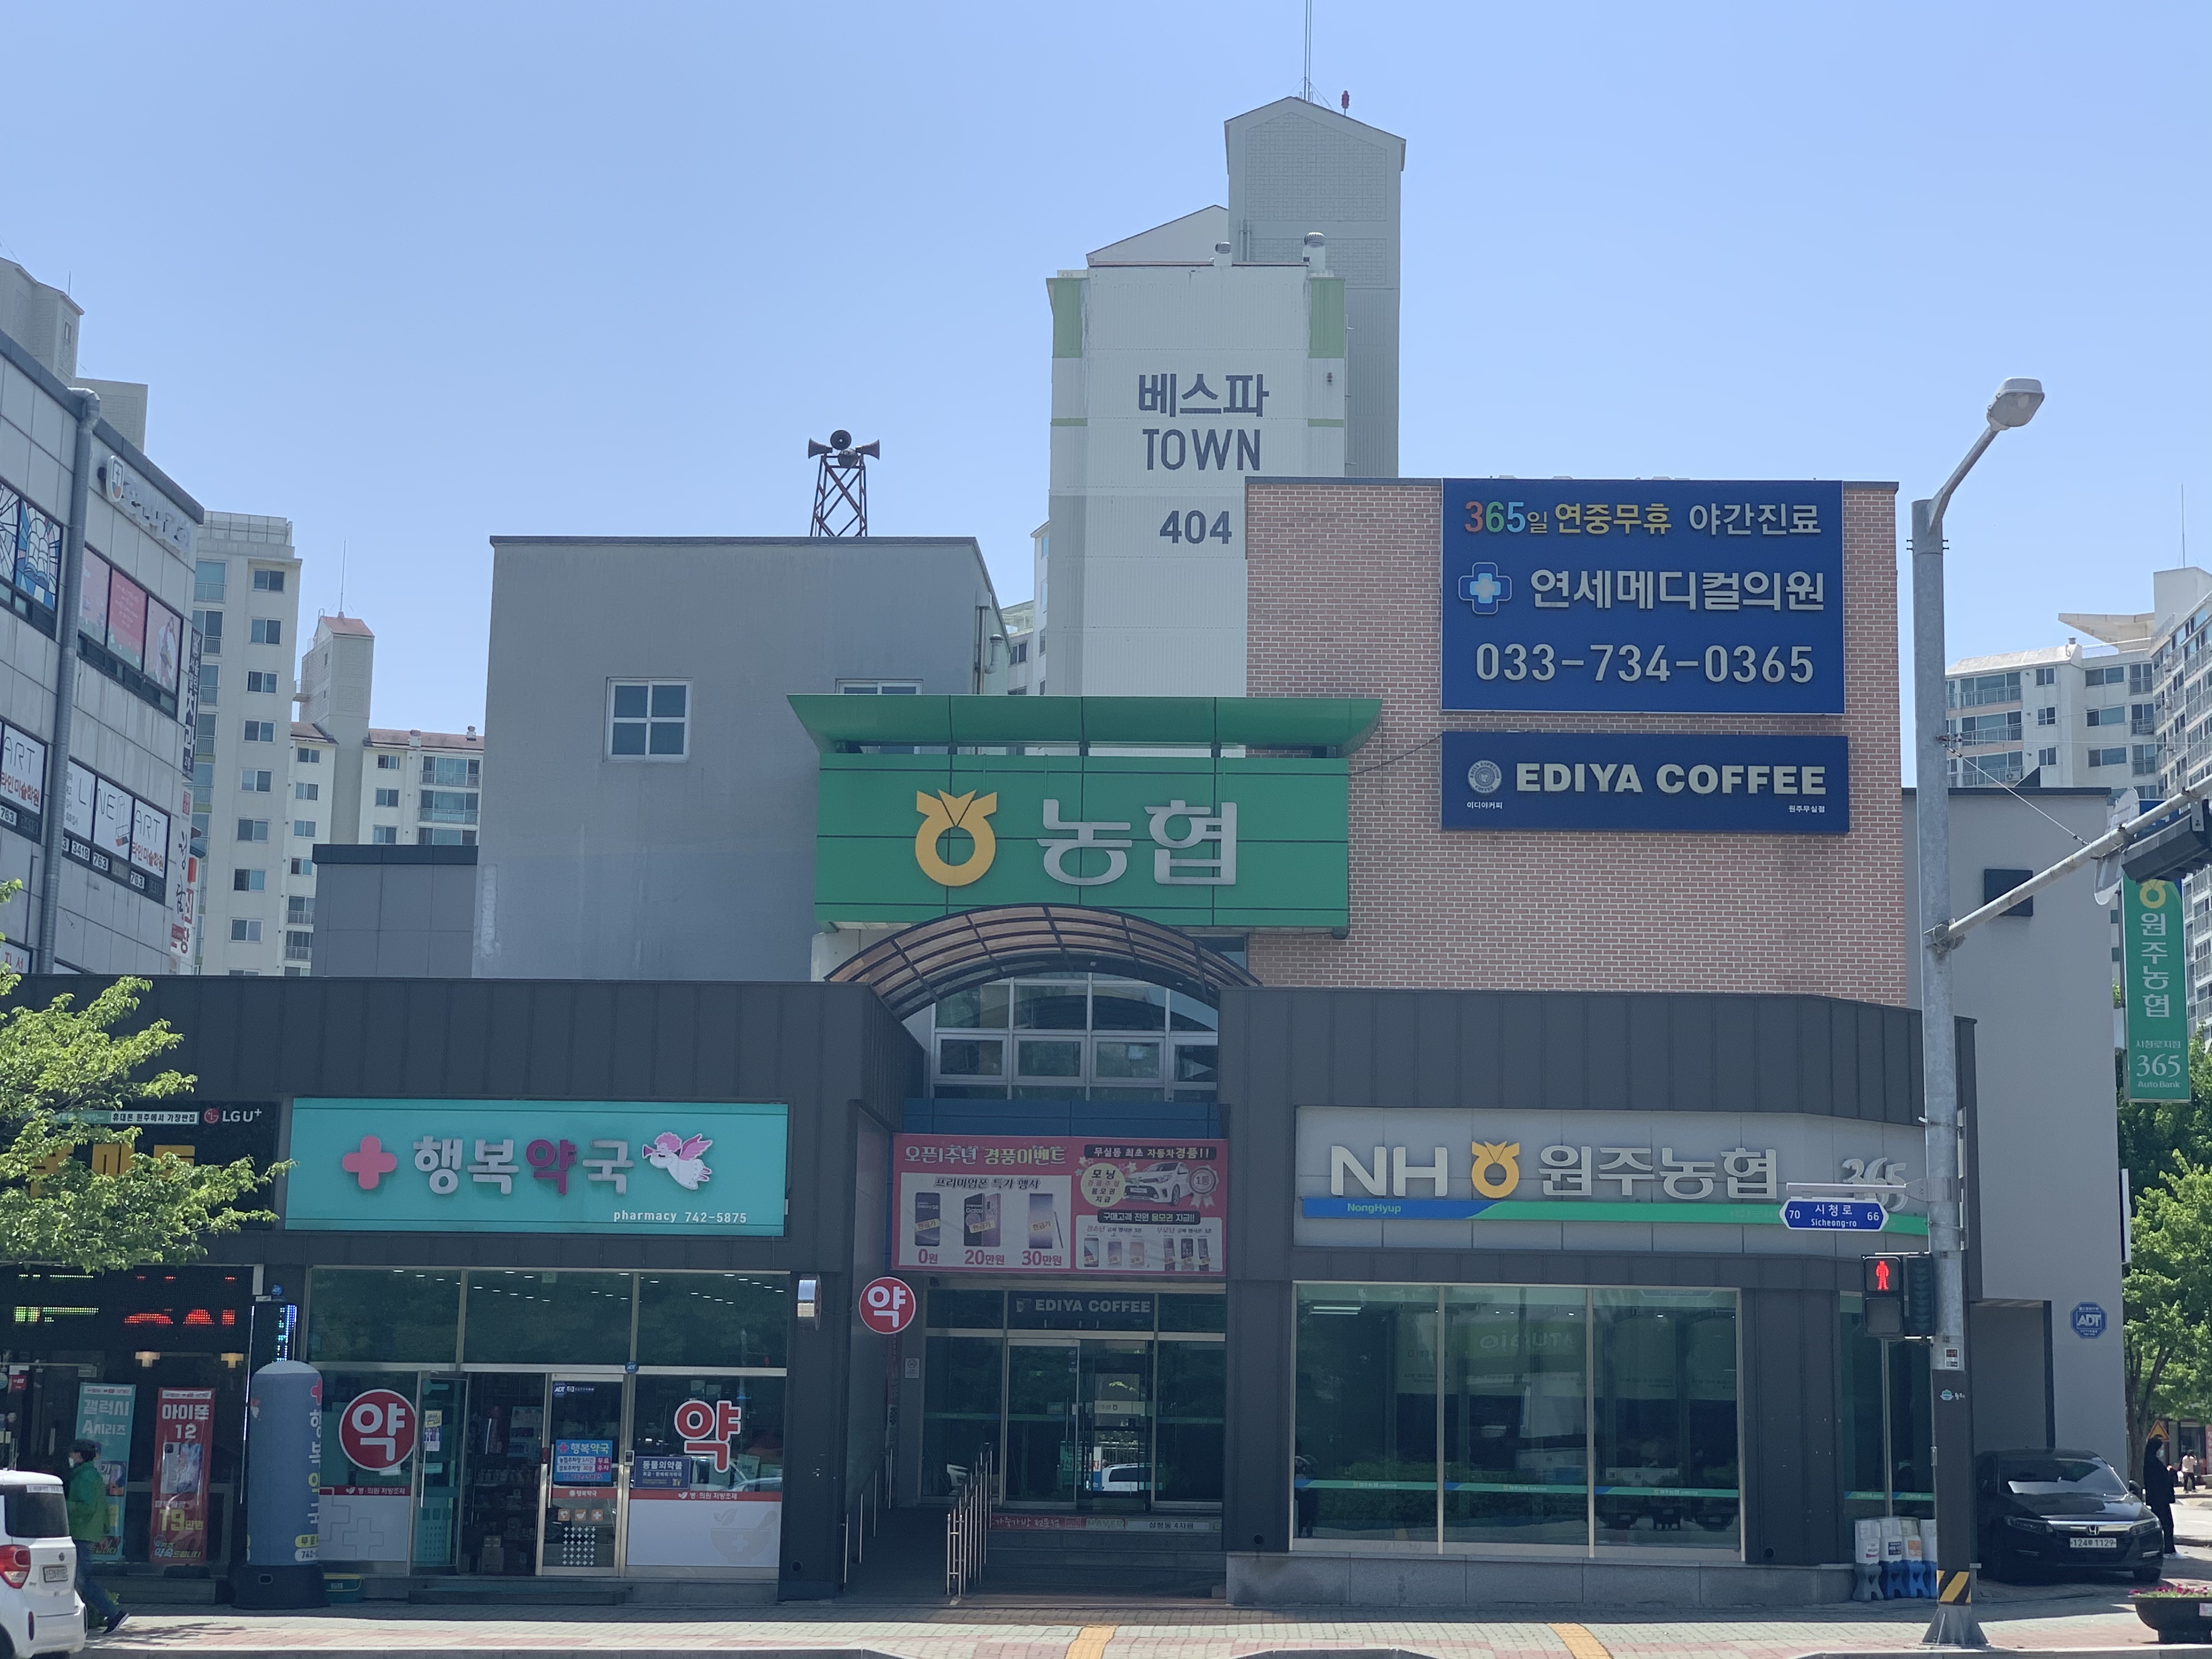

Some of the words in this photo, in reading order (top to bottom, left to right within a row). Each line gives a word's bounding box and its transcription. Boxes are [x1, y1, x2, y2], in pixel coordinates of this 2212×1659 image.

[1138, 373, 1269, 417] 베스파
[1142, 428, 1261, 471] TOWN
[1464, 501, 1548, 533] 365일
[1555, 503, 1672, 535] 연중무휴
[1689, 503, 1822, 536] 야간진료
[1160, 510, 1232, 544] 404
[1531, 569, 1825, 611] 연세메디컬의원
[1476, 642, 1814, 683] 033-734-0365
[4, 736, 35, 774] ART
[1516, 763, 1643, 793] EDIYA
[1656, 764, 1827, 795] COFFEE
[1, 806, 15, 822] 763
[1788, 804, 1826, 814] 원주무실점
[135, 809, 161, 843] ART
[1037, 798, 1238, 886] 농협
[72, 843, 89, 860] 3419
[93, 853, 107, 869] 763
[130, 873, 144, 888] 763
[2141, 912, 2170, 1018] 원주농협
[2135, 1040, 2181, 1049] 시청로지점
[2136, 1053, 2181, 1078] 365
[2159, 1080, 2181, 1088] Bank
[112, 1113, 133, 1122] 휴대폰
[136, 1113, 164, 1122] 원주에서
[222, 1110, 240, 1122] LG
[1093, 1147, 1122, 1158] 무실동
[1125, 1148, 1144, 1158] 최초
[412, 1135, 634, 1196] 행복약국
[1330, 1145, 1448, 1197] NH
[1538, 1144, 1778, 1199] 원주농협
[1091, 1169, 1116, 1180] 모닝
[934, 1177, 989, 1189] 프리미엄폰
[992, 1178, 1014, 1189] 특가
[1018, 1178, 1041, 1190] 행사
[613, 1209, 677, 1223] pharmacy
[685, 1211, 748, 1223] 742-5875
[1347, 1202, 1401, 1215] NongHyup
[1788, 1209, 1801, 1219] 70
[1815, 1204, 1853, 1217] 시청로
[1867, 1211, 1880, 1221] 66
[1103, 1212, 1132, 1222] 구매고객
[1135, 1212, 1149, 1222] 전원
[1810, 1218, 1857, 1228] Sicheong-ro
[918, 1248, 938, 1265] 0원
[964, 1249, 1005, 1266] 20만원
[1022, 1250, 1063, 1266] 30만원
[867, 1285, 906, 1328] 약
[1035, 1299, 1083, 1312] EDIYA
[1088, 1300, 1151, 1313] COFFEE
[2076, 1314, 2101, 1327] ADT
[83, 1400, 129, 1417] 갤럭시
[162, 1404, 210, 1420] 아이폰
[175, 1424, 196, 1440] 12
[351, 1403, 406, 1462] 약
[674, 1400, 741, 1473] 약
[571, 1442, 610, 1454] 행복약국
[642, 1460, 682, 1470] 동물의약품
[1086, 1518, 1126, 1530] NAVER
